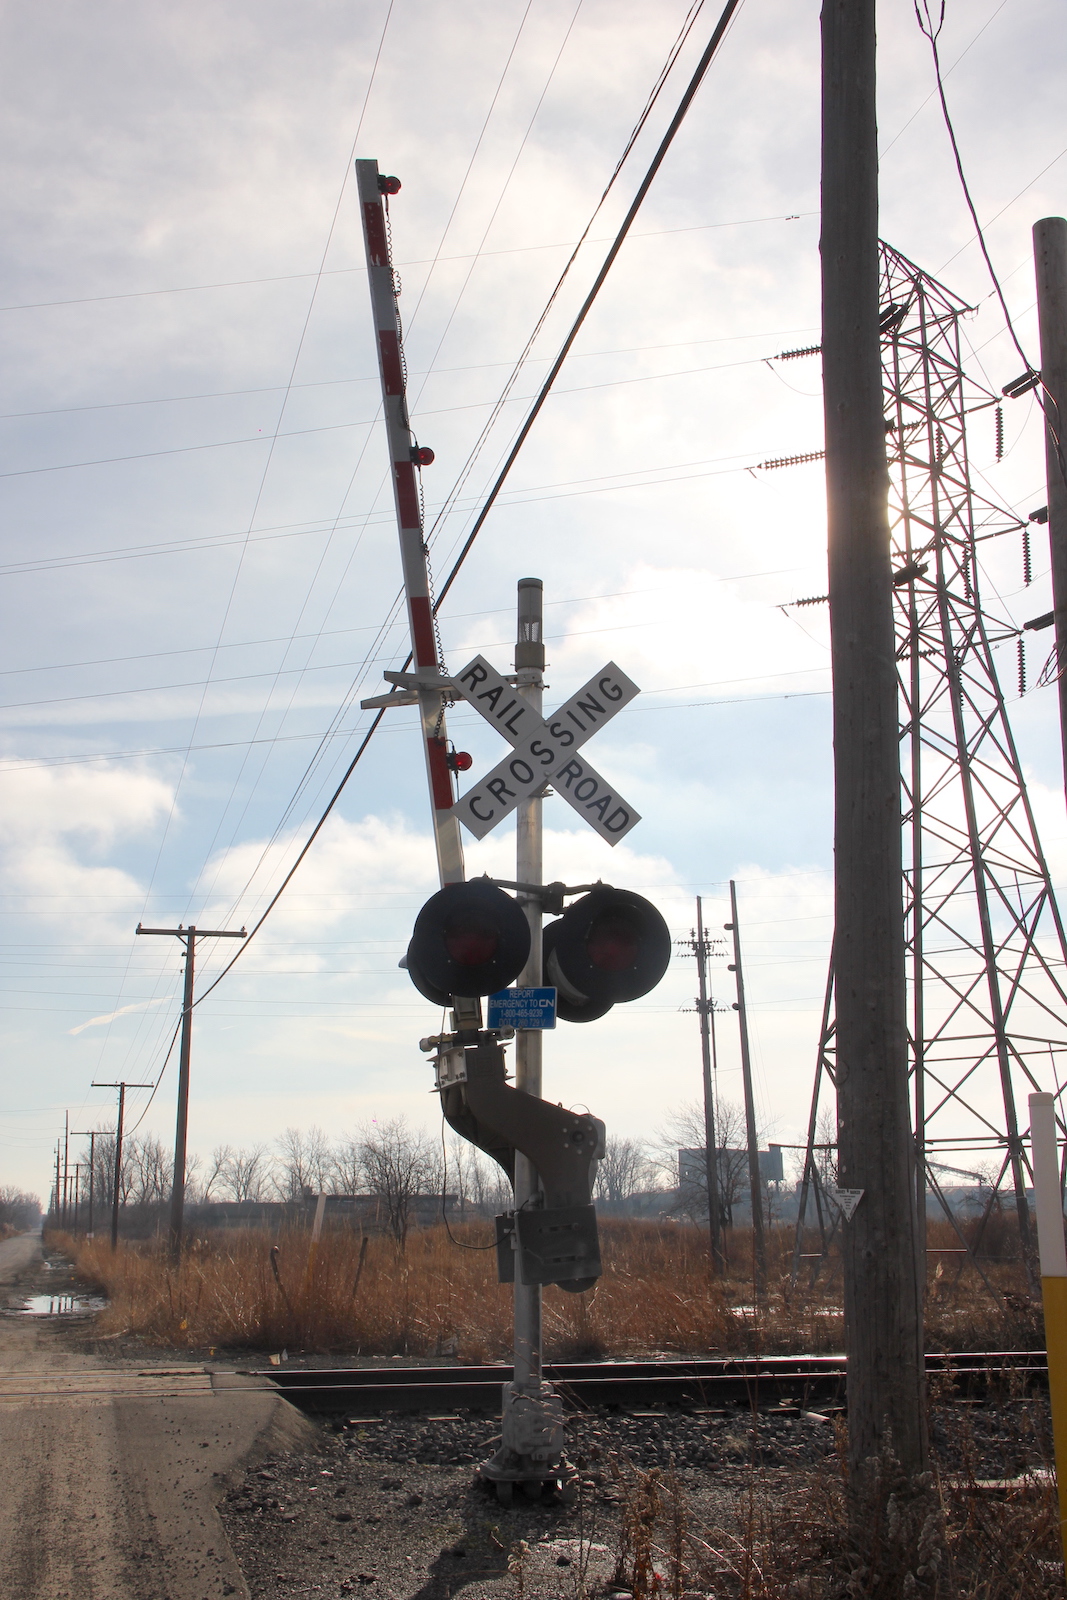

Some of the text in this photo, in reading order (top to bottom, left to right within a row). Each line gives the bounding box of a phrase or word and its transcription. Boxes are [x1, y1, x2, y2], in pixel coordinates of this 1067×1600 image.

[460, 663, 630, 832] RAIL ROAD
[469, 677, 623, 821] CROSSING
[490, 999, 554, 1008] EMERGENCY TO CN
[509, 990, 535, 998] REPORT
